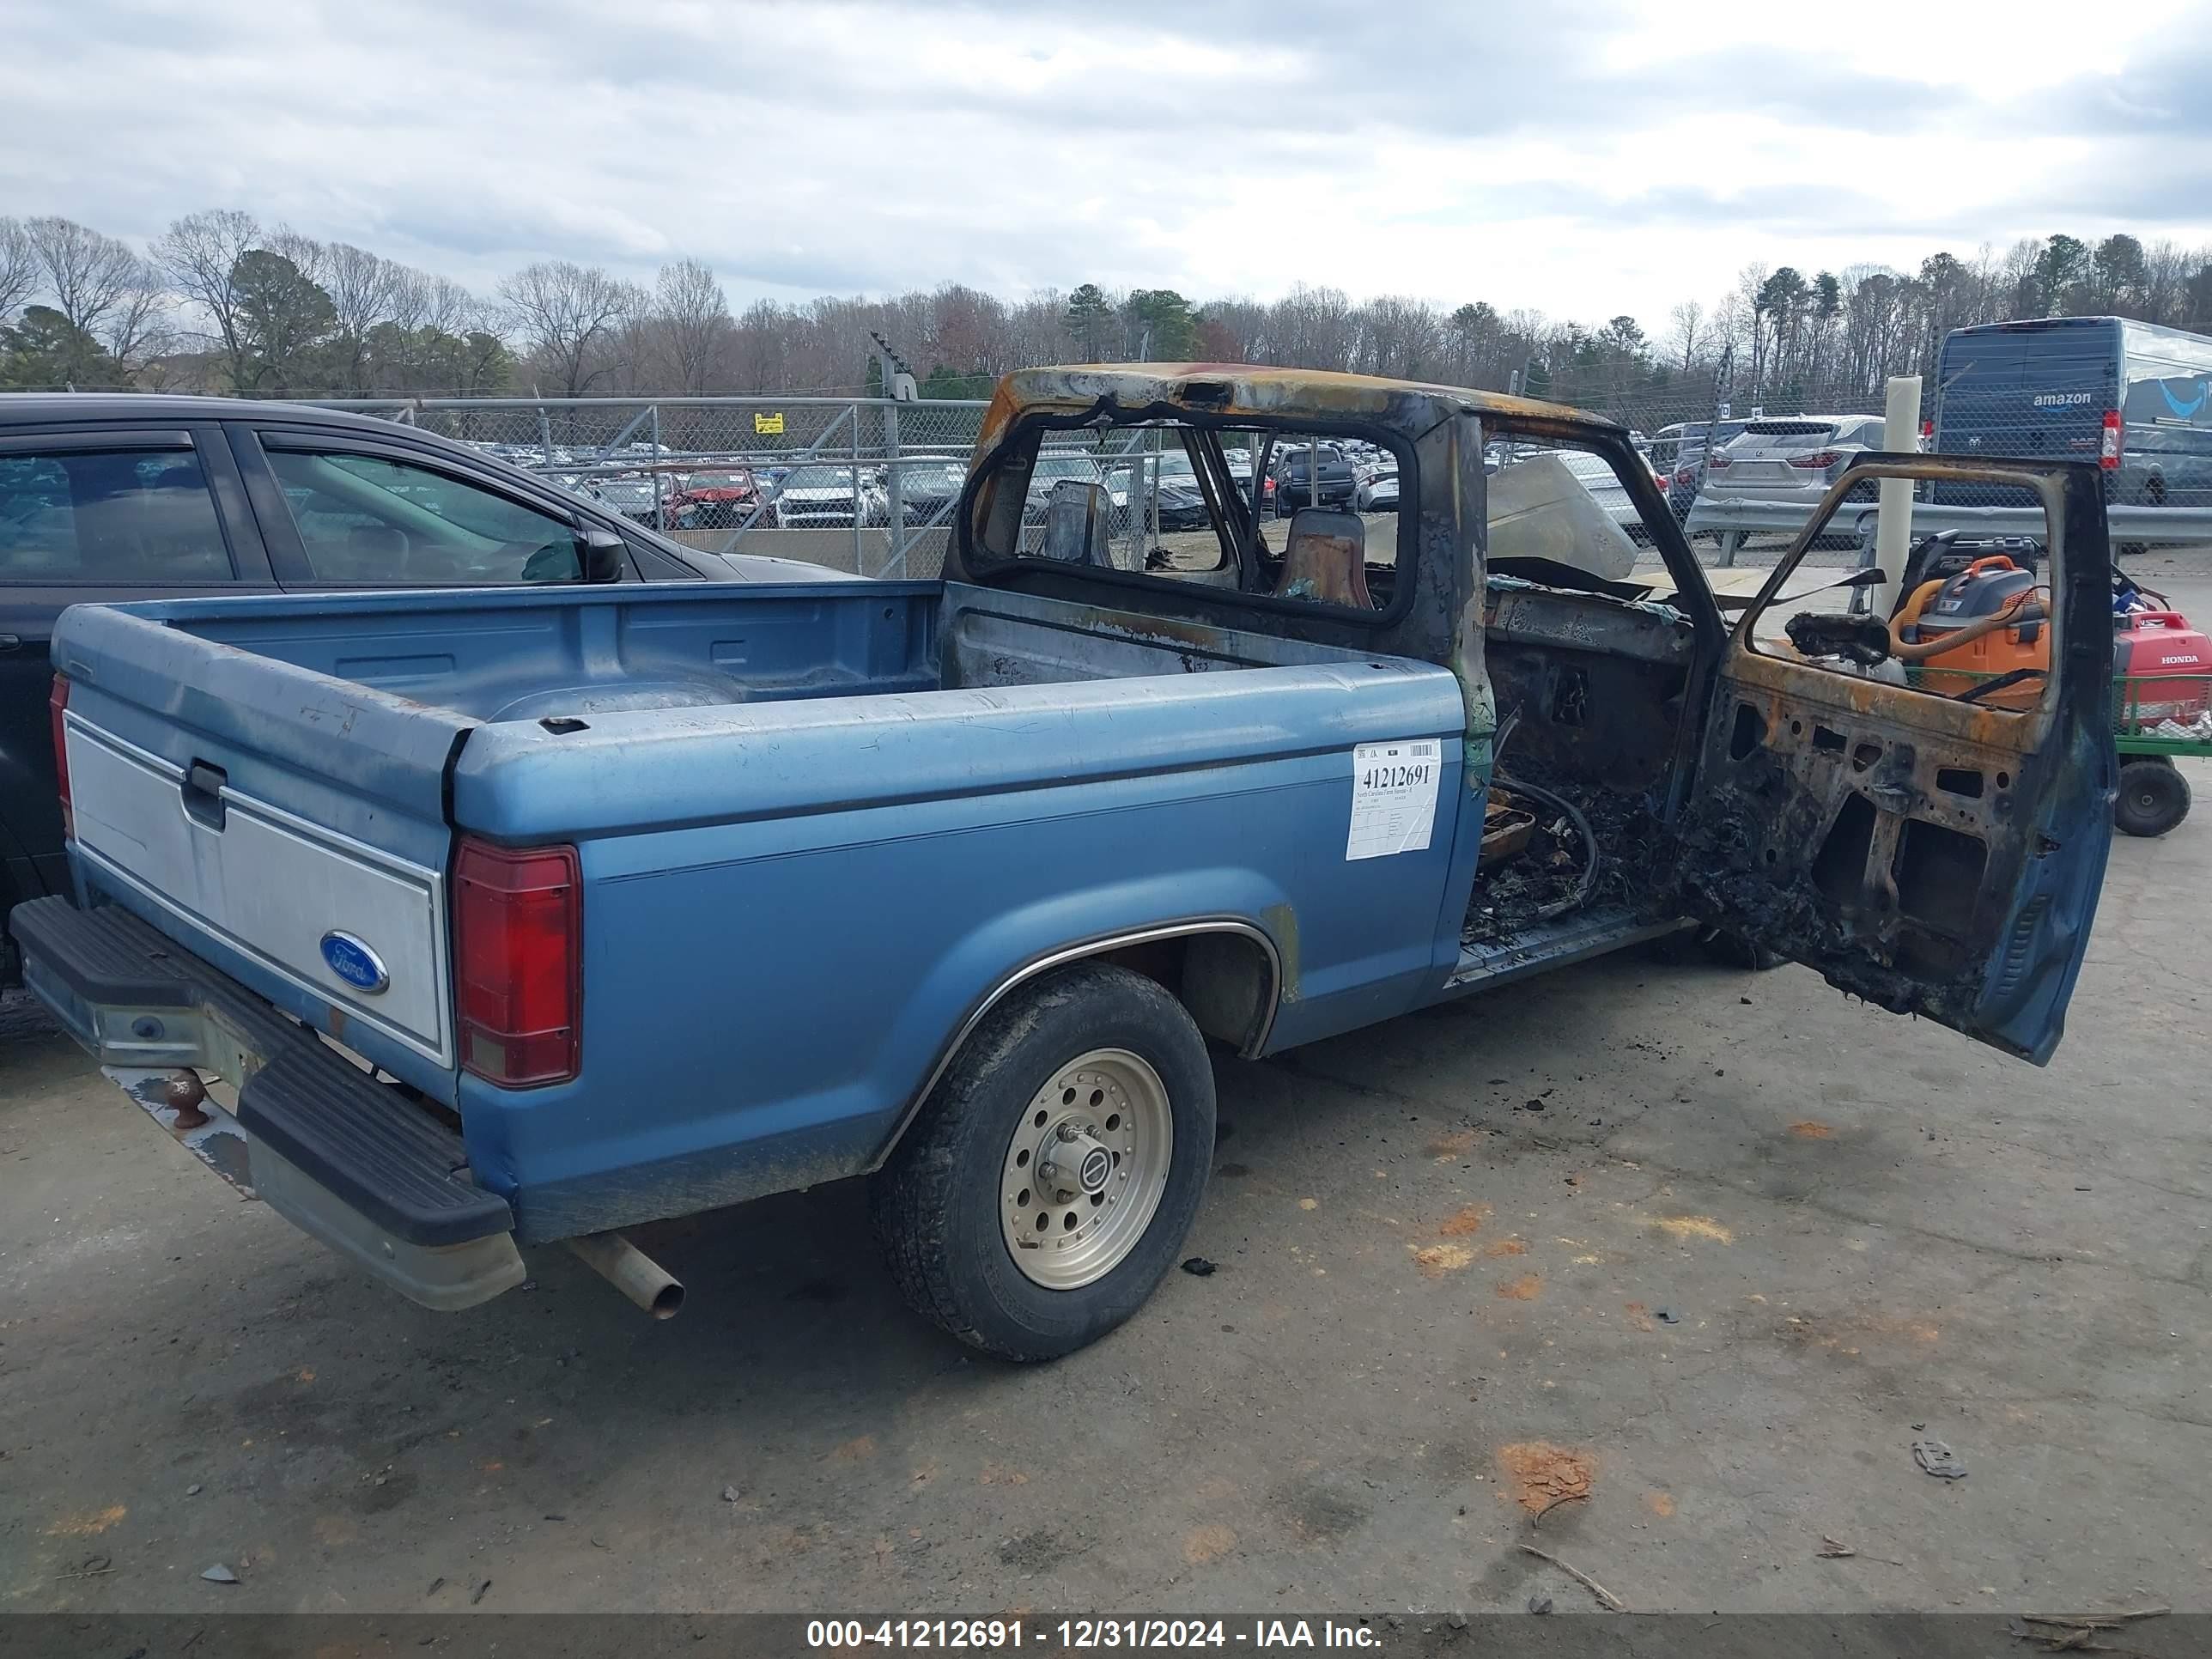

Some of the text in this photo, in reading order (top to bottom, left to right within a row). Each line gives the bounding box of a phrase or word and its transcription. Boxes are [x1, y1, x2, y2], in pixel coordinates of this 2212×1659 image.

[2033, 393, 2091, 406] amazon
[2161, 655, 2199, 665] HONDA
[1363, 764, 1430, 790] 41212691
[331, 944, 366, 980] Ford
